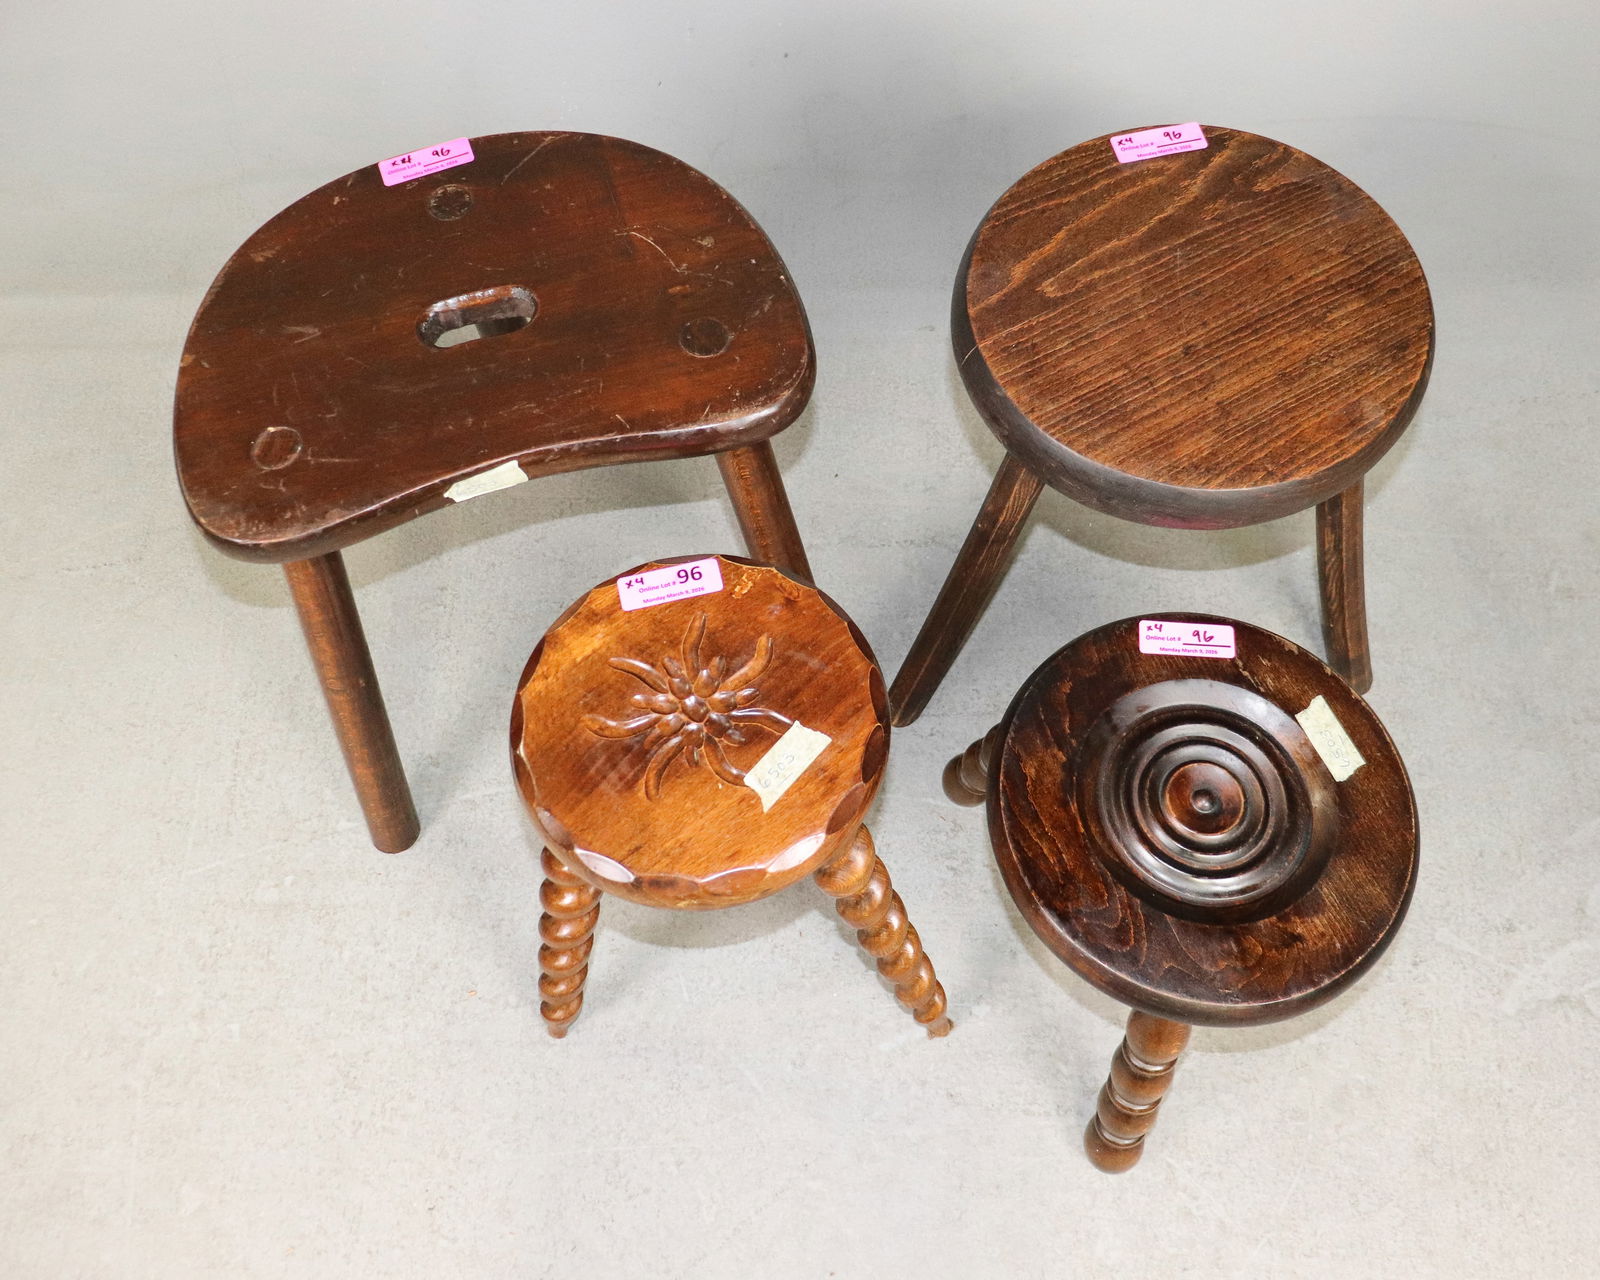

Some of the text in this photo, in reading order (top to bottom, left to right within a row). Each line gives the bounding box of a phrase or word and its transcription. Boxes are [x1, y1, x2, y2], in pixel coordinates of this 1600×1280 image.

[1120, 144, 1139, 152] Online
[1163, 131, 1182, 141] 96
[432, 148, 451, 157] 96
[403, 170, 424, 179] Monday
[638, 584, 660, 594] Online
[677, 566, 703, 584] 96
[643, 595, 666, 604] Monday
[666, 590, 684, 599] March
[1192, 629, 1214, 642] 96
